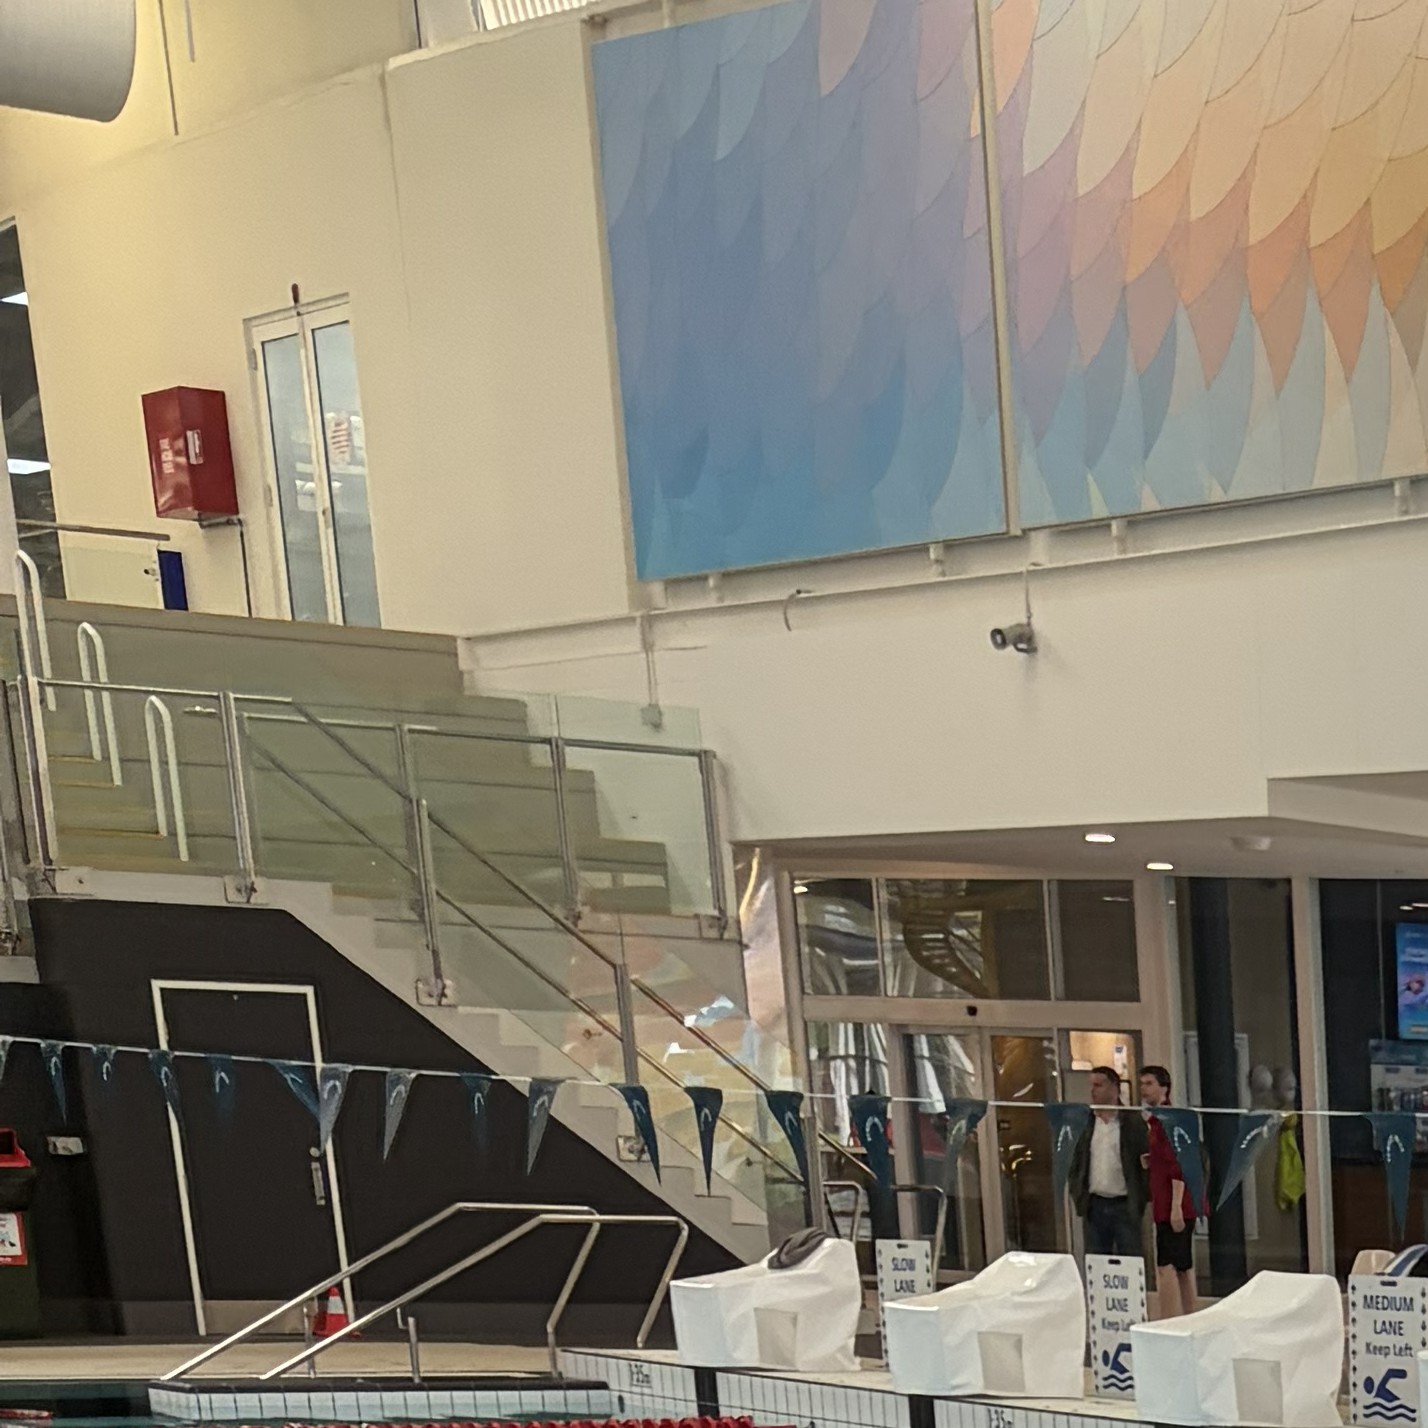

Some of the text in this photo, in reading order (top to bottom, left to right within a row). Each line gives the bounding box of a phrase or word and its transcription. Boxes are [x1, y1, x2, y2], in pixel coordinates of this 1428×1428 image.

[1102, 1273, 1129, 1290] SLOW
[1105, 1297, 1129, 1312] LANE
[1362, 1294, 1415, 1312] MEDIUM
[1373, 1319, 1404, 1337] LANE
[1365, 1341, 1414, 1358] Keep Left
